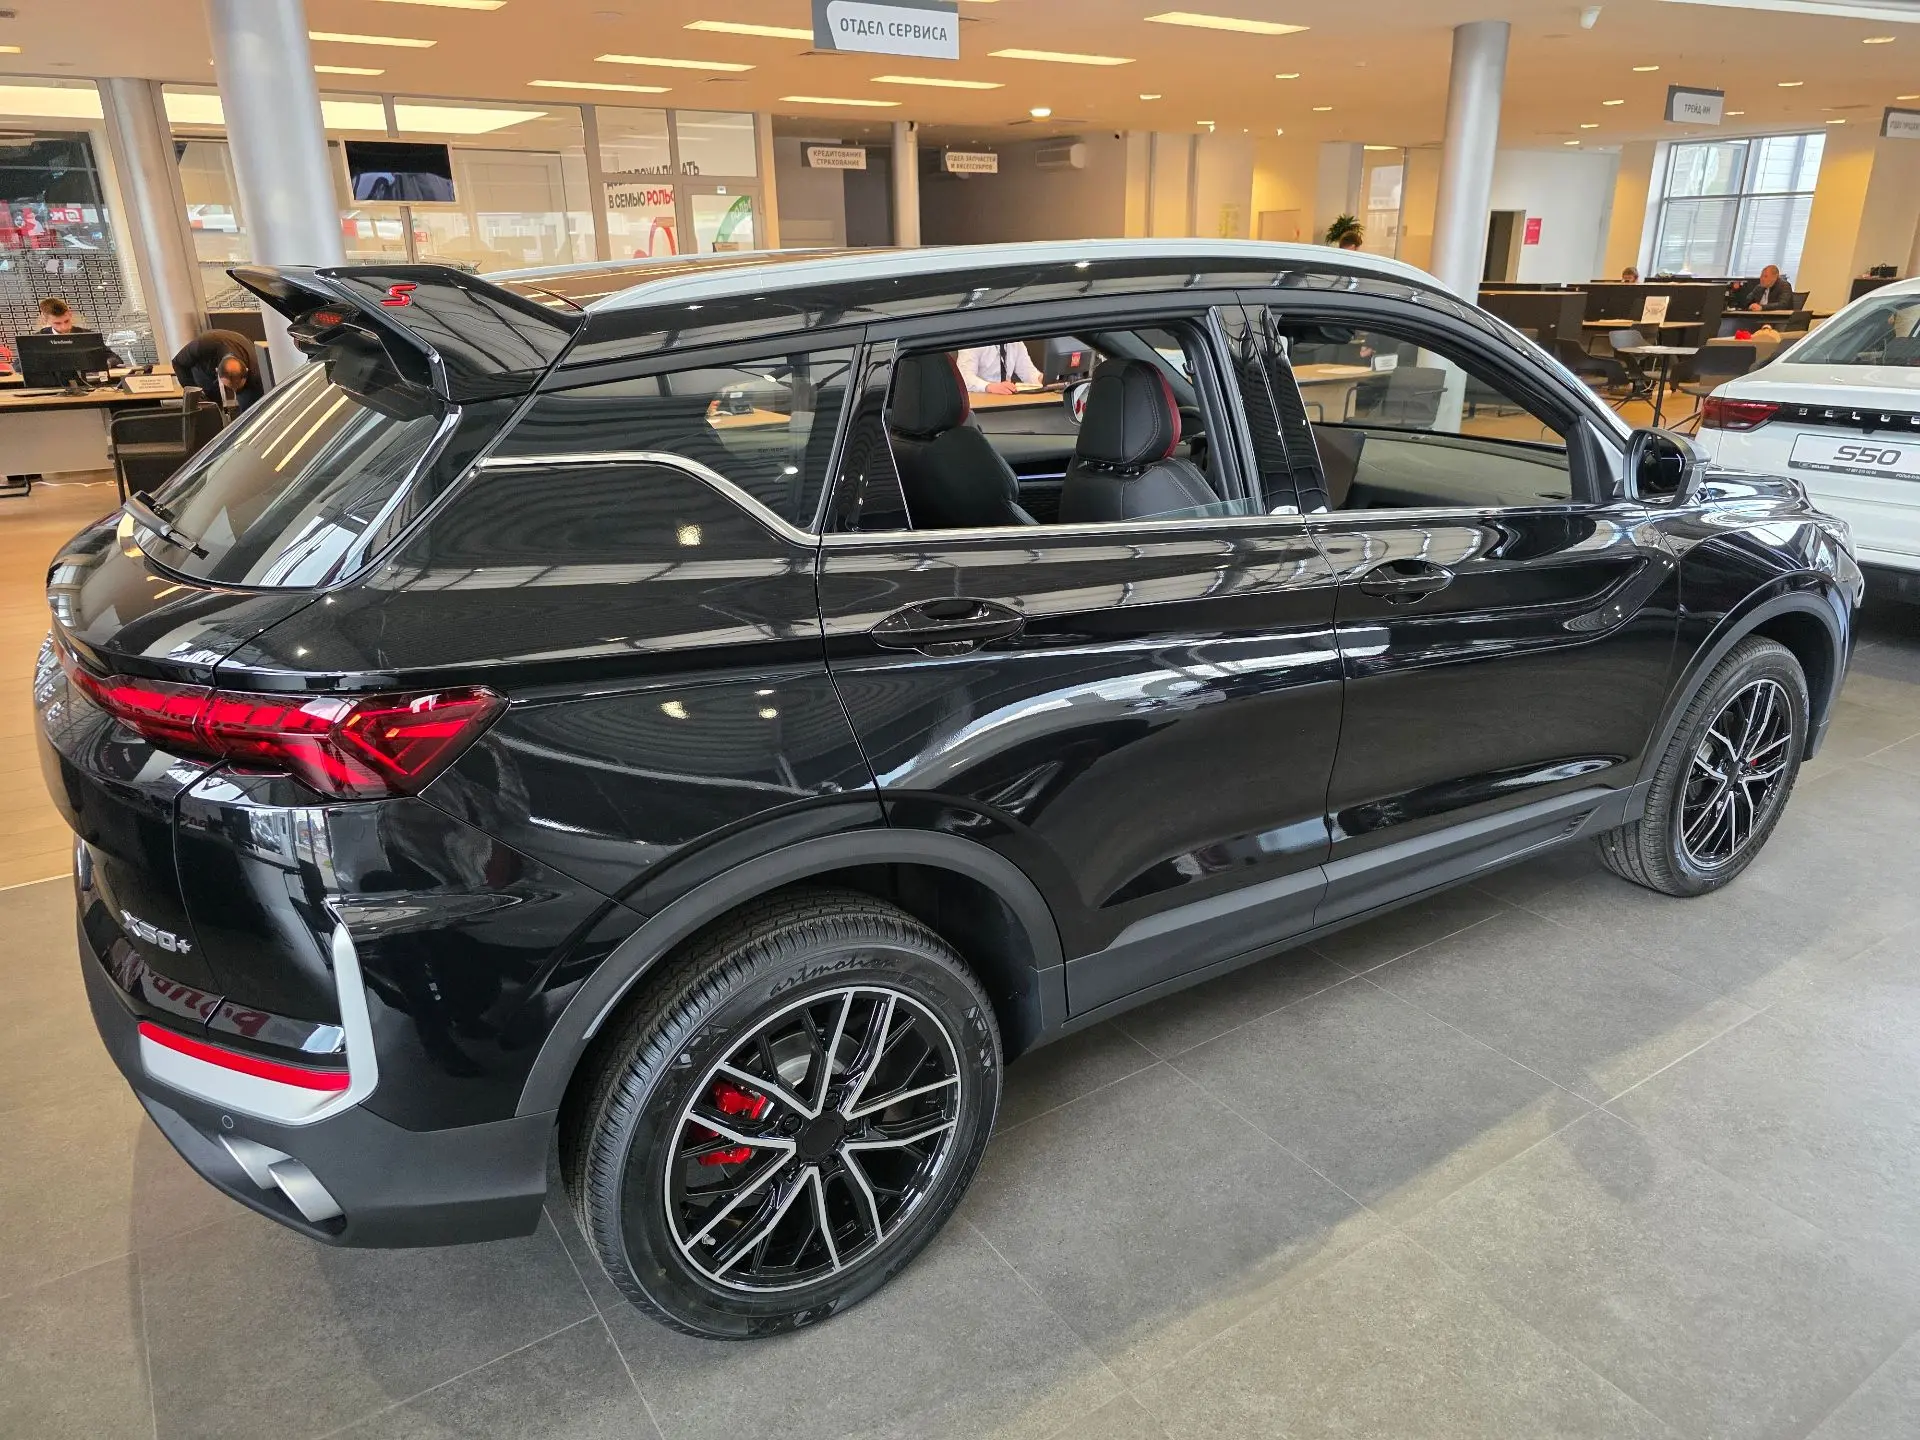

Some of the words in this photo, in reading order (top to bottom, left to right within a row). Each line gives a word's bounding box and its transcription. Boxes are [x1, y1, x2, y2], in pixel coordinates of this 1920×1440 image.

[840, 17, 885, 36] ОТДЕЛ
[888, 22, 948, 42] СЕРВИСА
[1684, 103, 1711, 115] ТРЕЙД-ИН
[813, 150, 862, 158] КРЕДИТОВАНИЕ
[816, 158, 860, 167] СТРАХОВАНИЕ
[609, 195, 615, 209] В
[615, 191, 646, 208] СЕМЬЮ
[1833, 445, 1902, 466] S50
[120, 909, 192, 954] X50+
